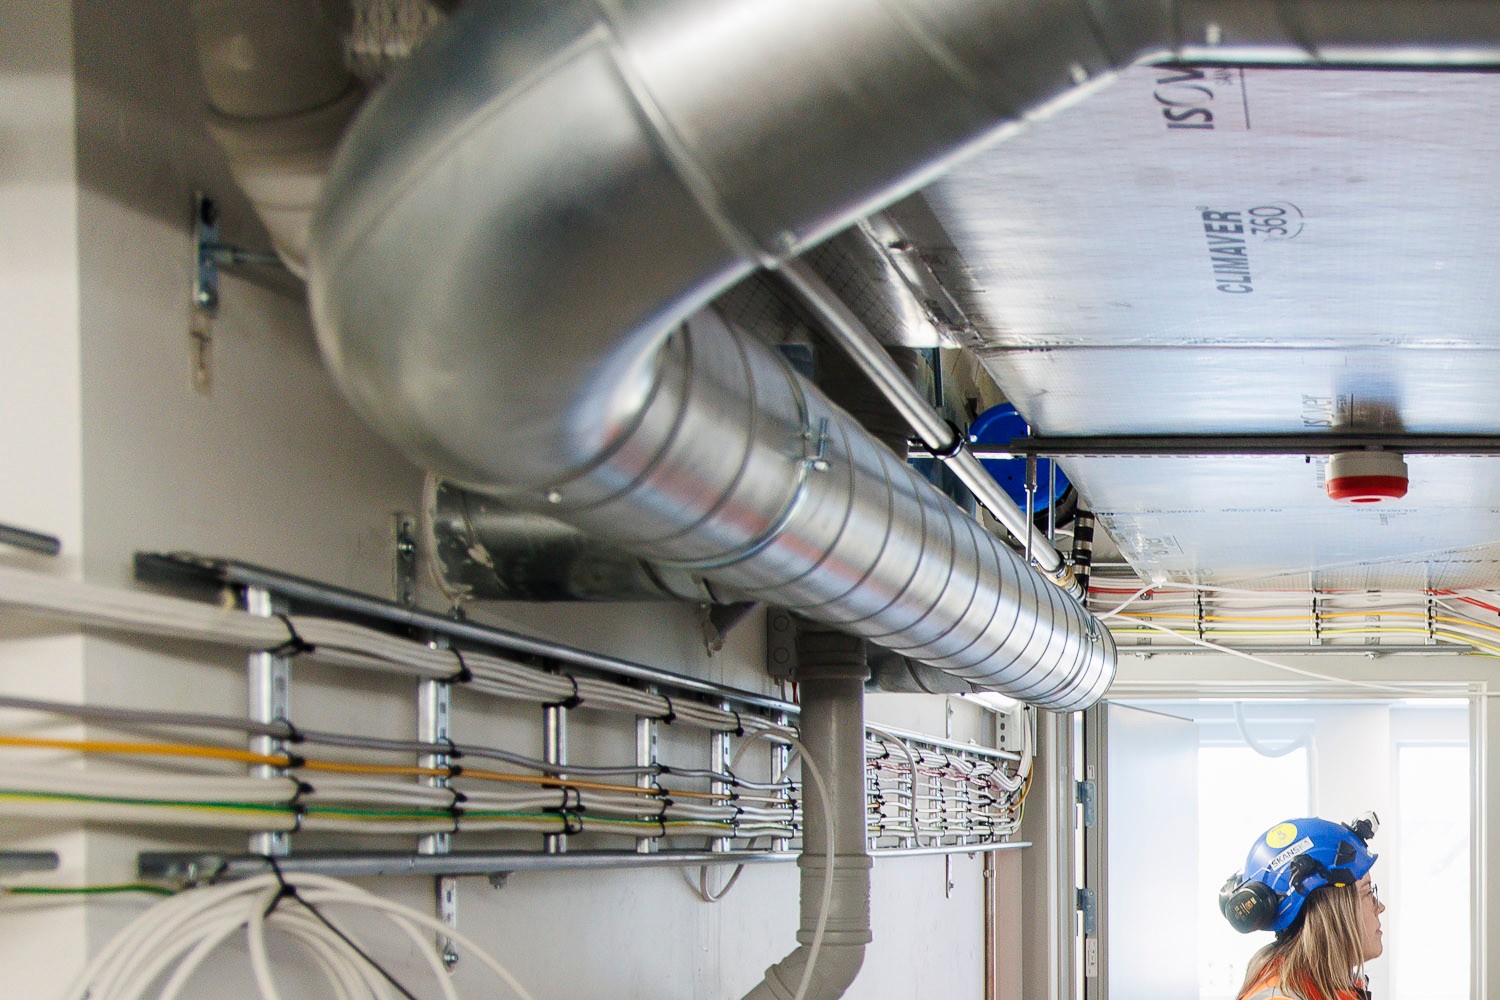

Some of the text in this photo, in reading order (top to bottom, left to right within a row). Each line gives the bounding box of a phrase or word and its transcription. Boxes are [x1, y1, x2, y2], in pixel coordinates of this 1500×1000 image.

[1248, 205, 1288, 236] 360
[1201, 208, 1254, 294] CLIMAVER
[1271, 839, 1311, 868] SKANSKA
